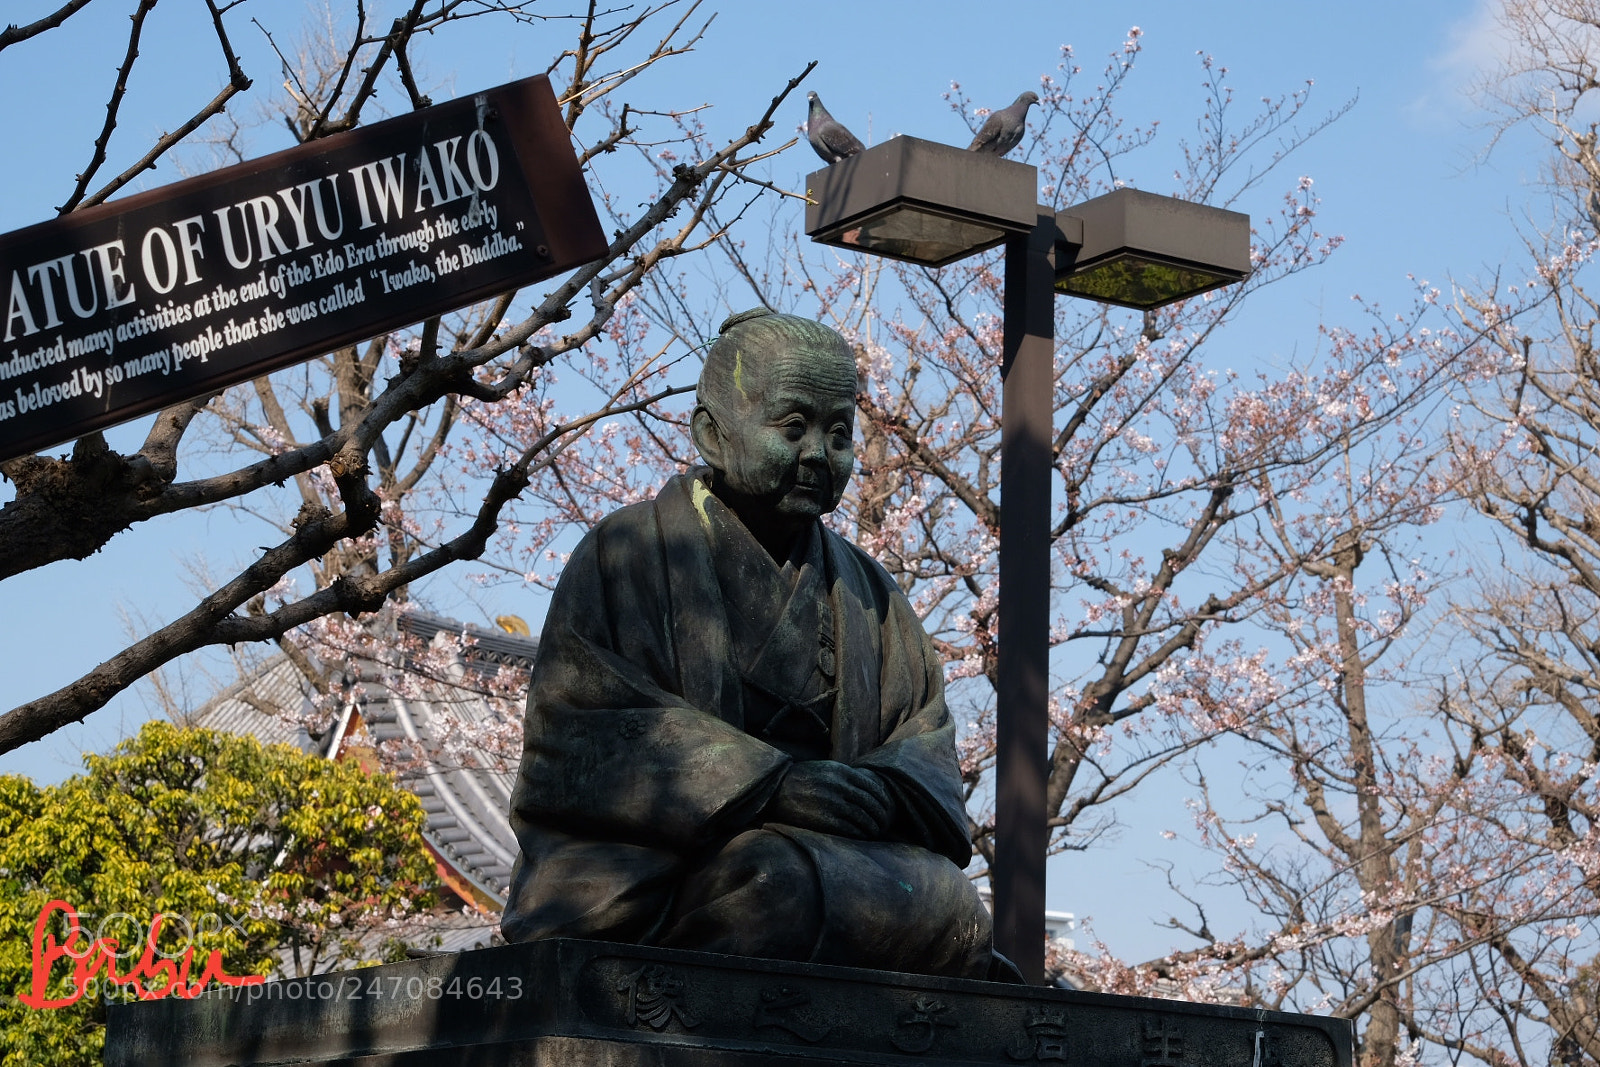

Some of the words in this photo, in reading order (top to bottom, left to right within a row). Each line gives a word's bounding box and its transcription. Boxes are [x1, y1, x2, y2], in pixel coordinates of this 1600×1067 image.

[0, 334, 67, 380] nducted
[66, 327, 114, 355] many
[116, 301, 193, 342] activities
[194, 296, 211, 318] at
[211, 284, 238, 311] the
[240, 270, 269, 302] end
[269, 264, 286, 299] of
[286, 260, 312, 287] the
[311, 249, 345, 279] Edo
[343, 243, 376, 268] Era
[376, 217, 434, 258] through
[435, 213, 459, 240] the
[461, 200, 498, 232] early
[3, 239, 136, 342] ATUE
[141, 215, 205, 294] OF
[213, 173, 343, 269] URYU
[348, 129, 499, 230] IWAKO
[15, 369, 82, 414] beloved
[80, 366, 103, 398] by
[104, 365, 124, 385] so
[123, 348, 171, 376] many
[171, 325, 224, 364] people
[223, 317, 259, 346] that
[259, 307, 286, 335] she
[286, 301, 318, 325] was
[319, 277, 365, 314] called
[434, 252, 460, 276] the
